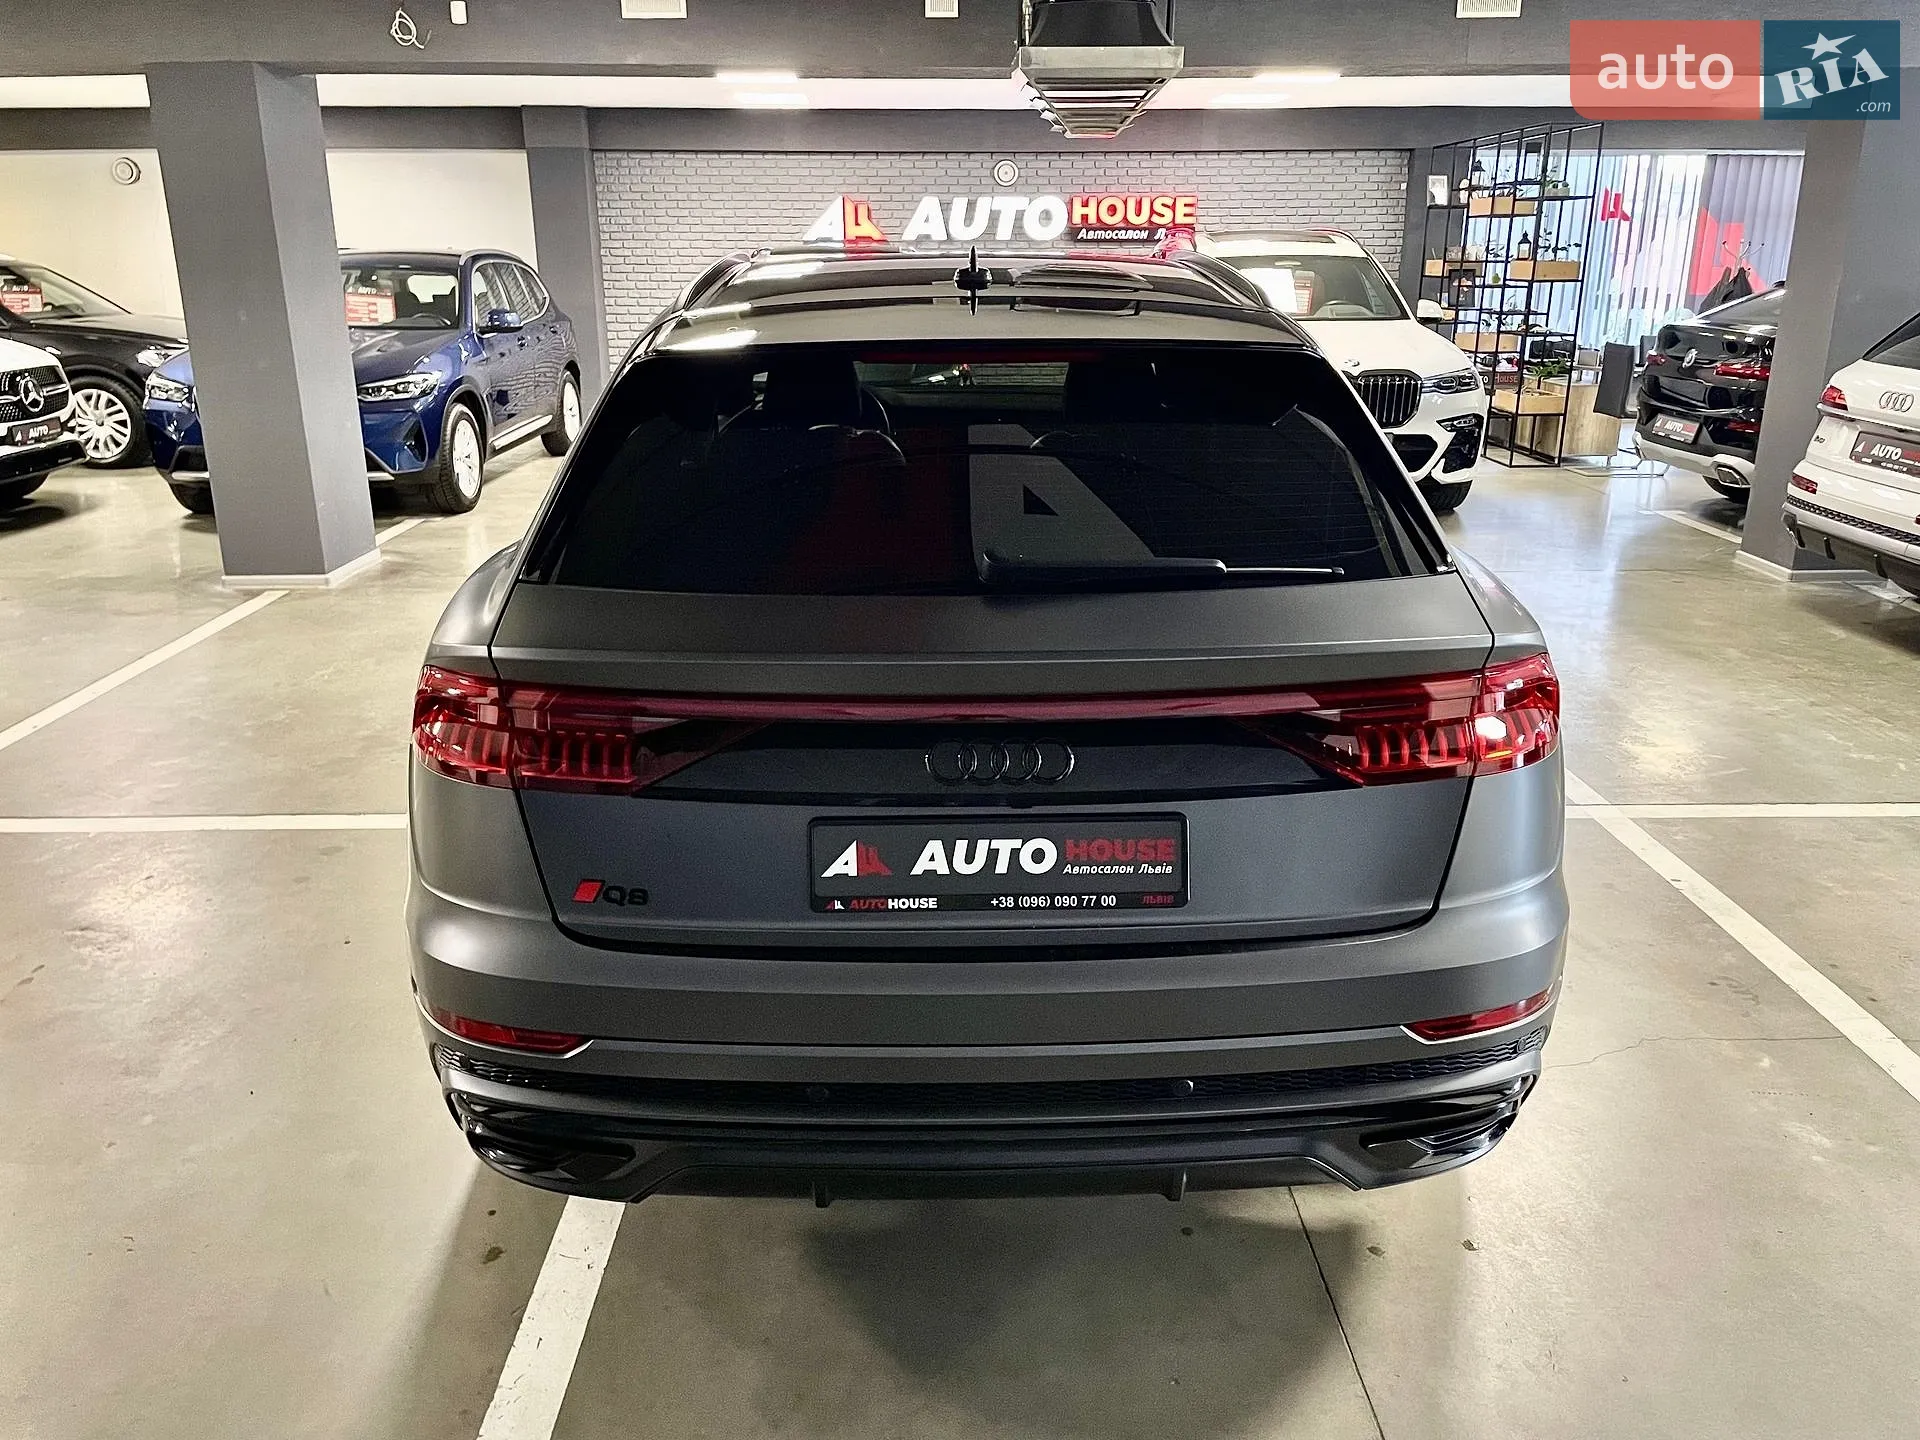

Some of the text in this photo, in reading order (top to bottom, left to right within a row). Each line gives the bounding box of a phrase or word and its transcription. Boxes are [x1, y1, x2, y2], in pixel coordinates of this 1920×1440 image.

[901, 195, 1068, 240] AUTO
[1071, 195, 1197, 226] HOUSE
[1077, 228, 1149, 240] Автосалон
[28, 425, 49, 439] AUTO
[1664, 420, 1684, 432] AUTO
[1870, 443, 1902, 461] AUTO
[909, 837, 1058, 876] AUTO
[1065, 838, 1175, 862] HOUSE
[1063, 862, 1173, 875] Автосалон Львів
[602, 885, 649, 907] Q8
[991, 895, 1117, 908] +38 (096) 090 77 00
